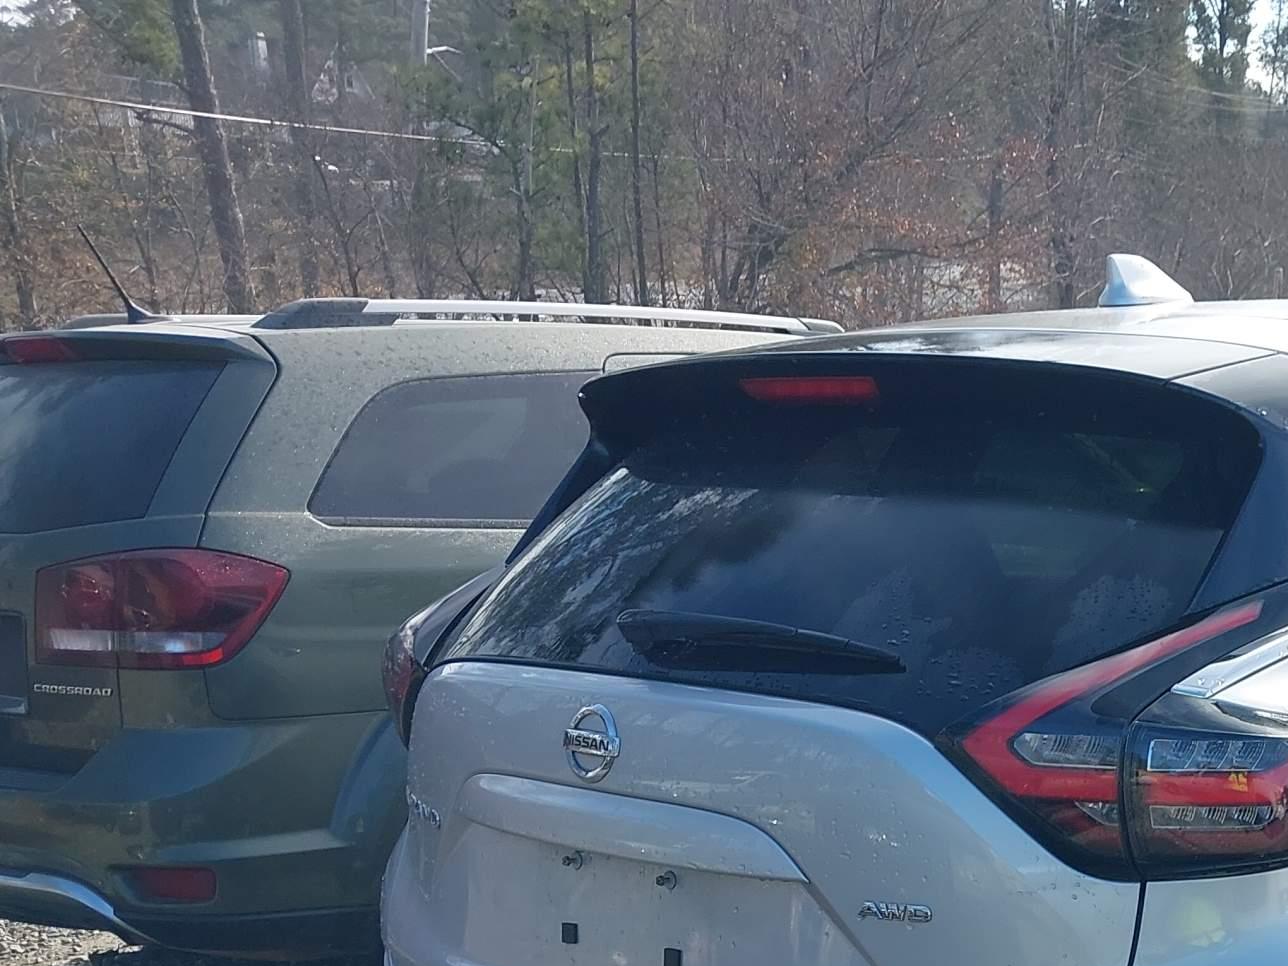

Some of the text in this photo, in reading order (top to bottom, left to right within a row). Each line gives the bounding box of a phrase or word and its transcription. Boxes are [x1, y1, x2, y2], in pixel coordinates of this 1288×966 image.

[33, 683, 112, 697] CROSSROAD
[563, 730, 610, 752] NISSAN
[858, 900, 933, 922] AWD
